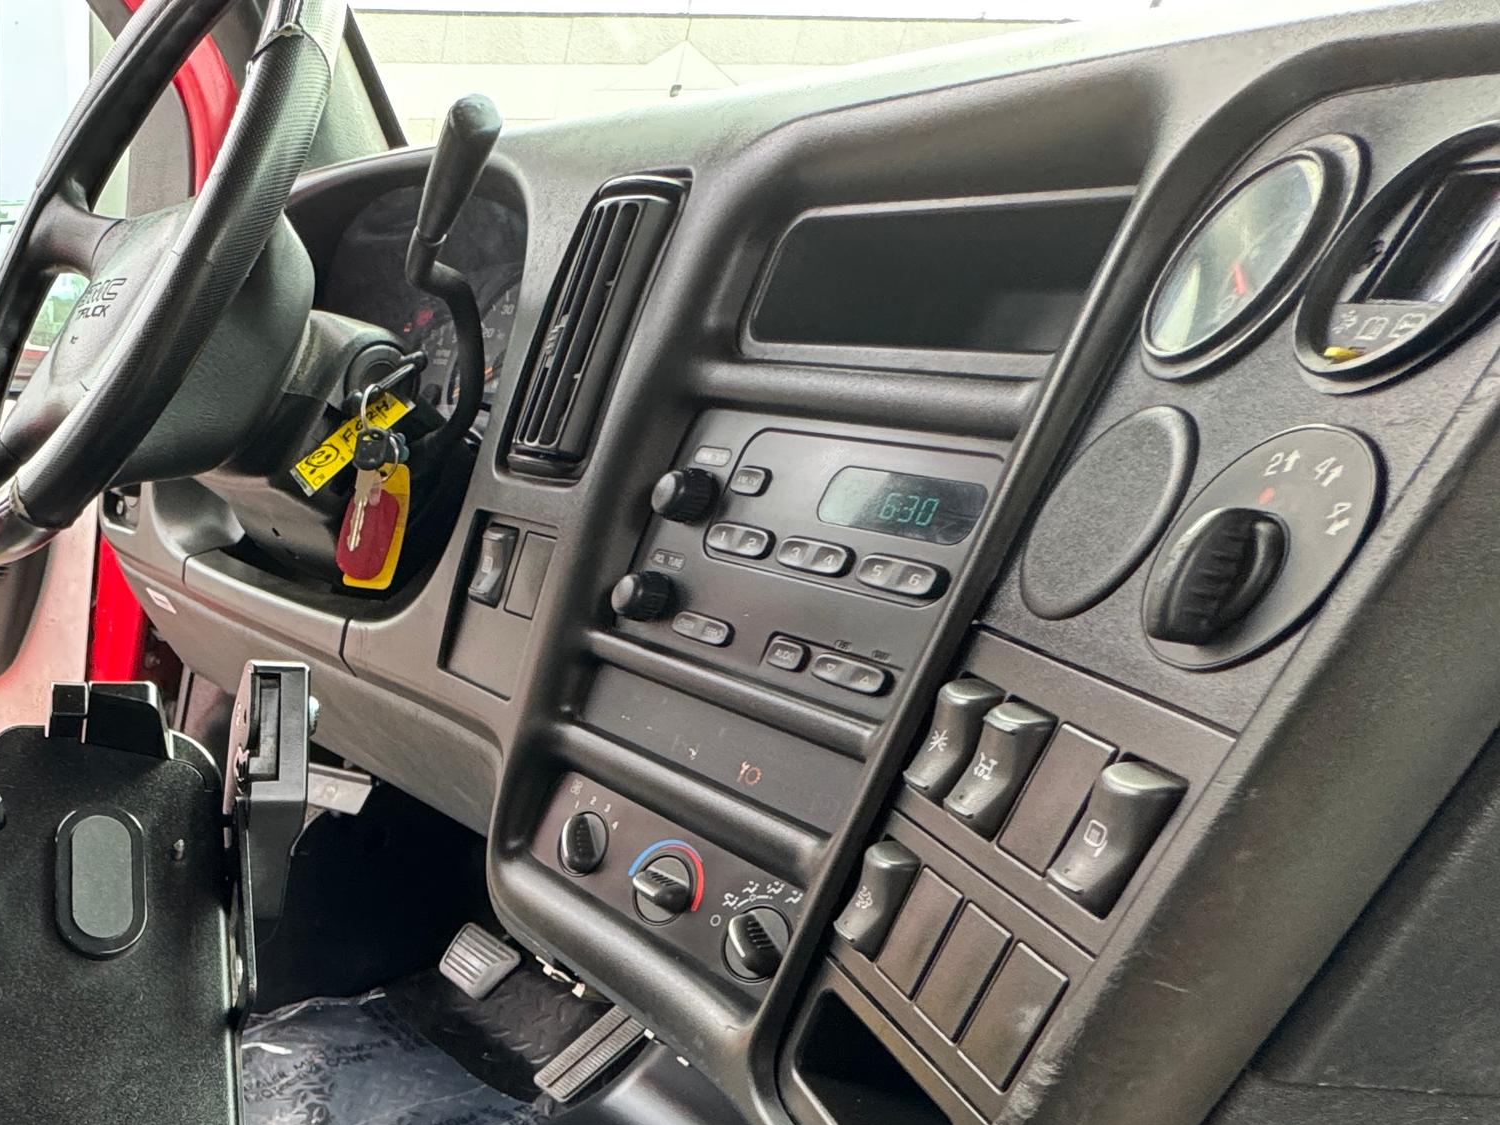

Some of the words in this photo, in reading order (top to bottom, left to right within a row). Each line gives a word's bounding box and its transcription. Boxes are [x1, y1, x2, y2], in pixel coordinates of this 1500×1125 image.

[1263, 452, 1285, 477] 2
[1315, 456, 1337, 480] 4
[878, 492, 940, 527] 6:30
[872, 565, 884, 577] 5
[908, 574, 922, 587] 6
